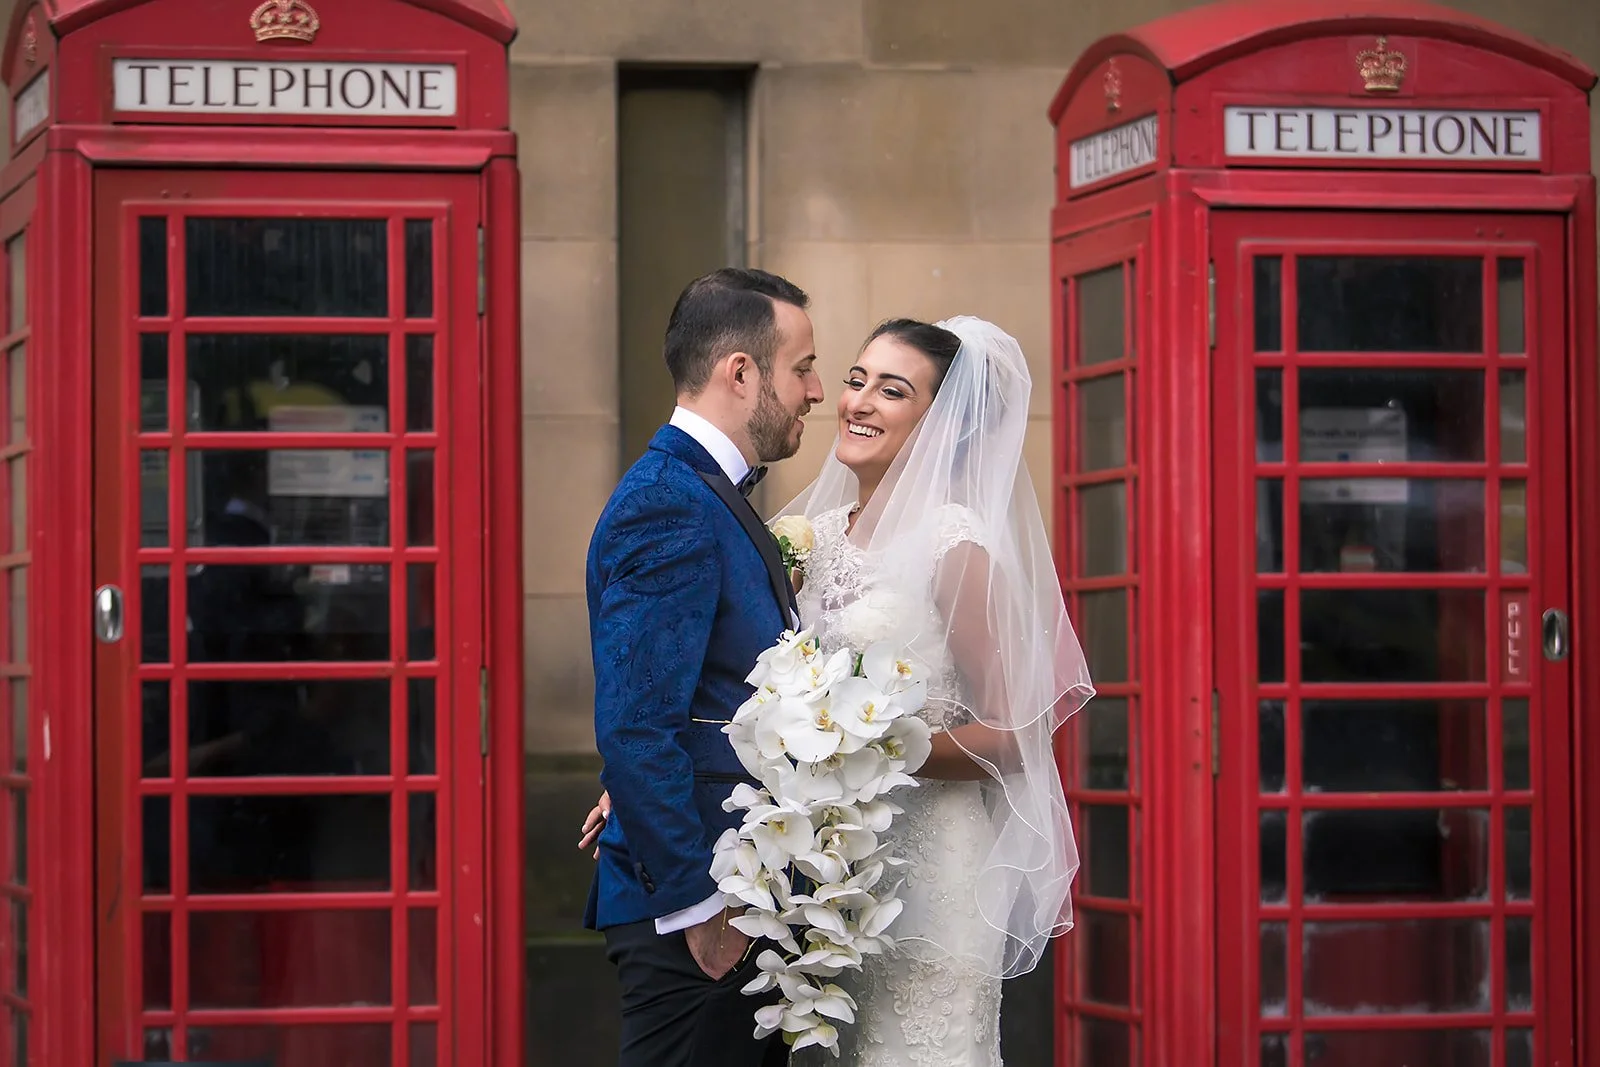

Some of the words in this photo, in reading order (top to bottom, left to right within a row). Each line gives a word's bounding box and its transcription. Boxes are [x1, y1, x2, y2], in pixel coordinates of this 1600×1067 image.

[128, 65, 443, 110] TELEPHONE
[1237, 111, 1527, 156] TELEPHONE
[1507, 602, 1520, 674] PULL
